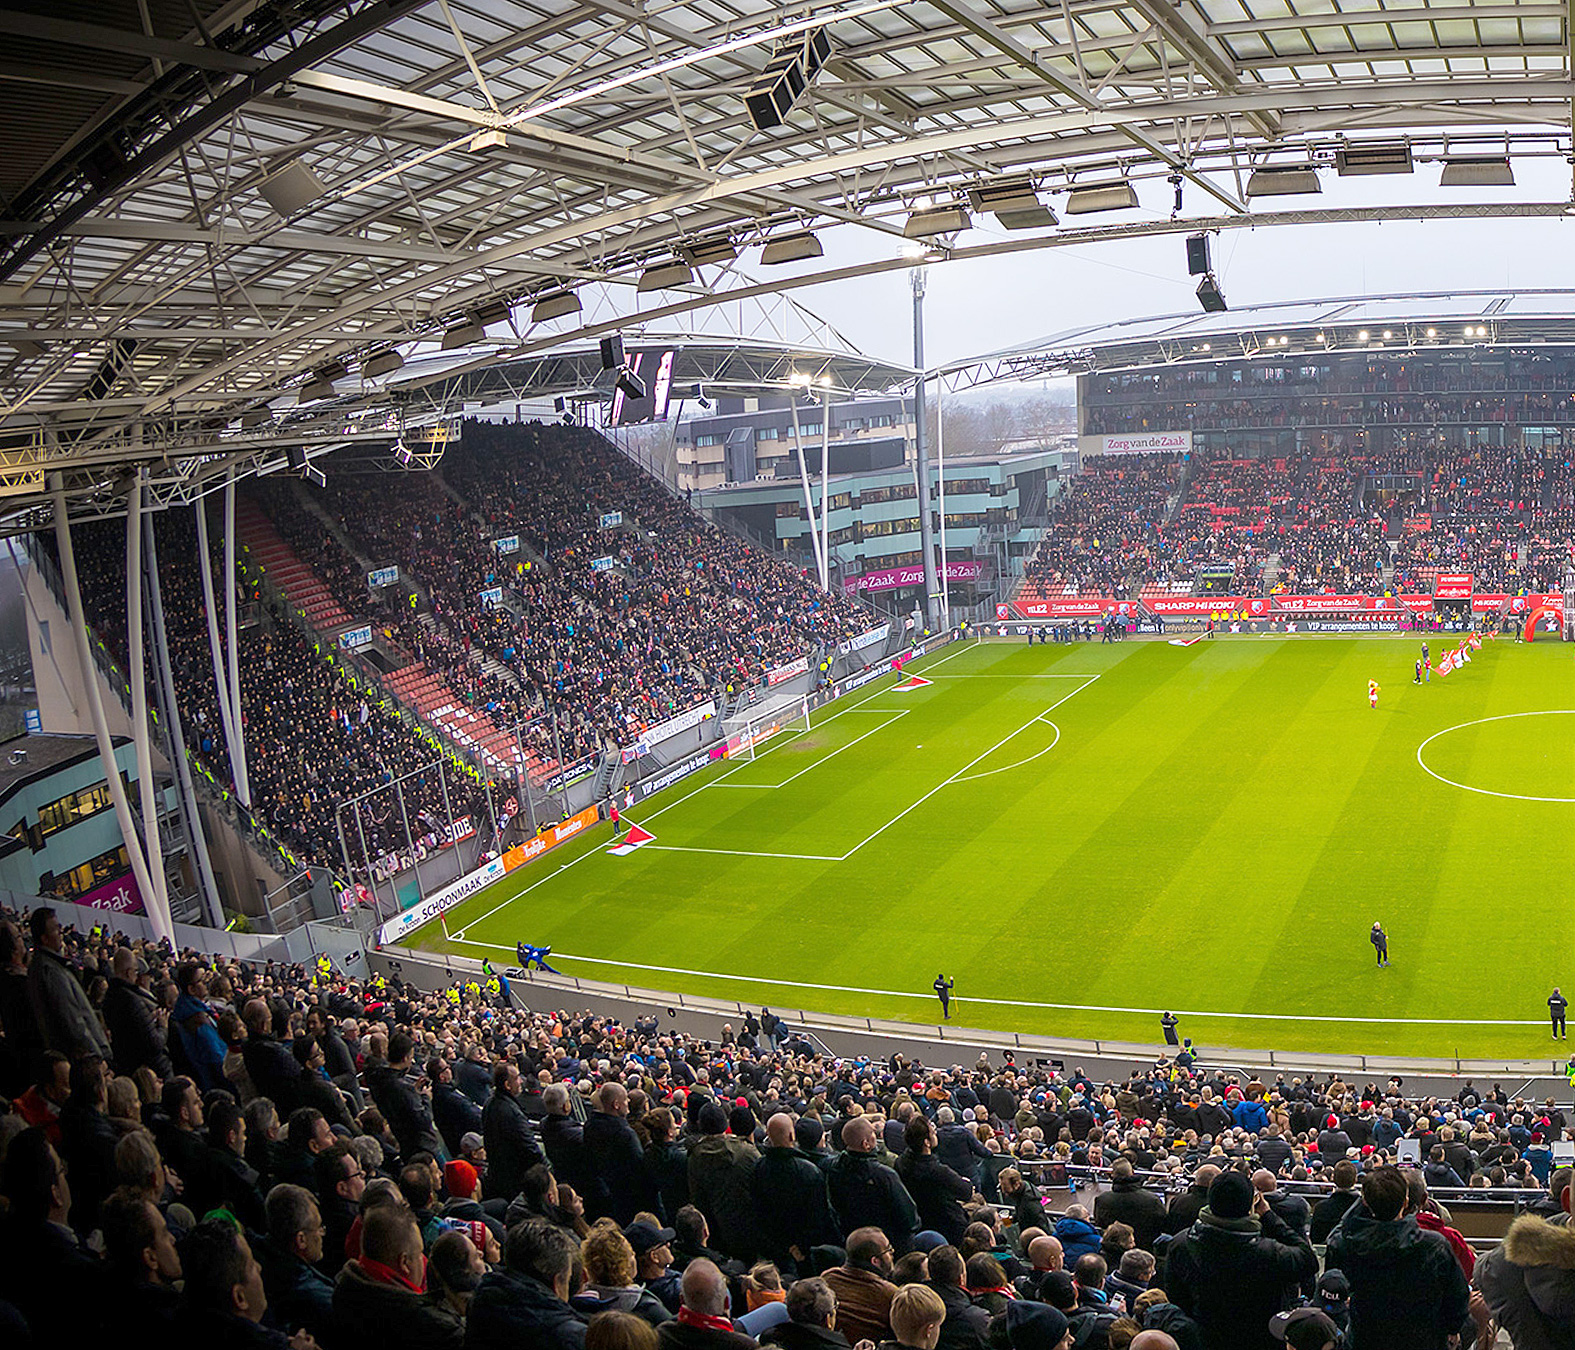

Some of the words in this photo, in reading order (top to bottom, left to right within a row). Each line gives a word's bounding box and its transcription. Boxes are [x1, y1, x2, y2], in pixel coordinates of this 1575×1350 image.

[1108, 438, 1130, 450] Zorg
[1161, 436, 1184, 446] Zaak
[868, 575, 895, 588] Zaak
[900, 571, 925, 583] Zorg
[1027, 605, 1047, 614] TELE2
[1154, 602, 1195, 610] SHARP
[1281, 600, 1304, 609] TELE2
[1308, 622, 1320, 630] VIP
[1321, 622, 1370, 632] arrangementen
[1370, 622, 1378, 630] te
[350, 629, 370, 644] Prins
[444, 816, 473, 842] SIDE
[422, 876, 483, 920] SCHOONMAAK
